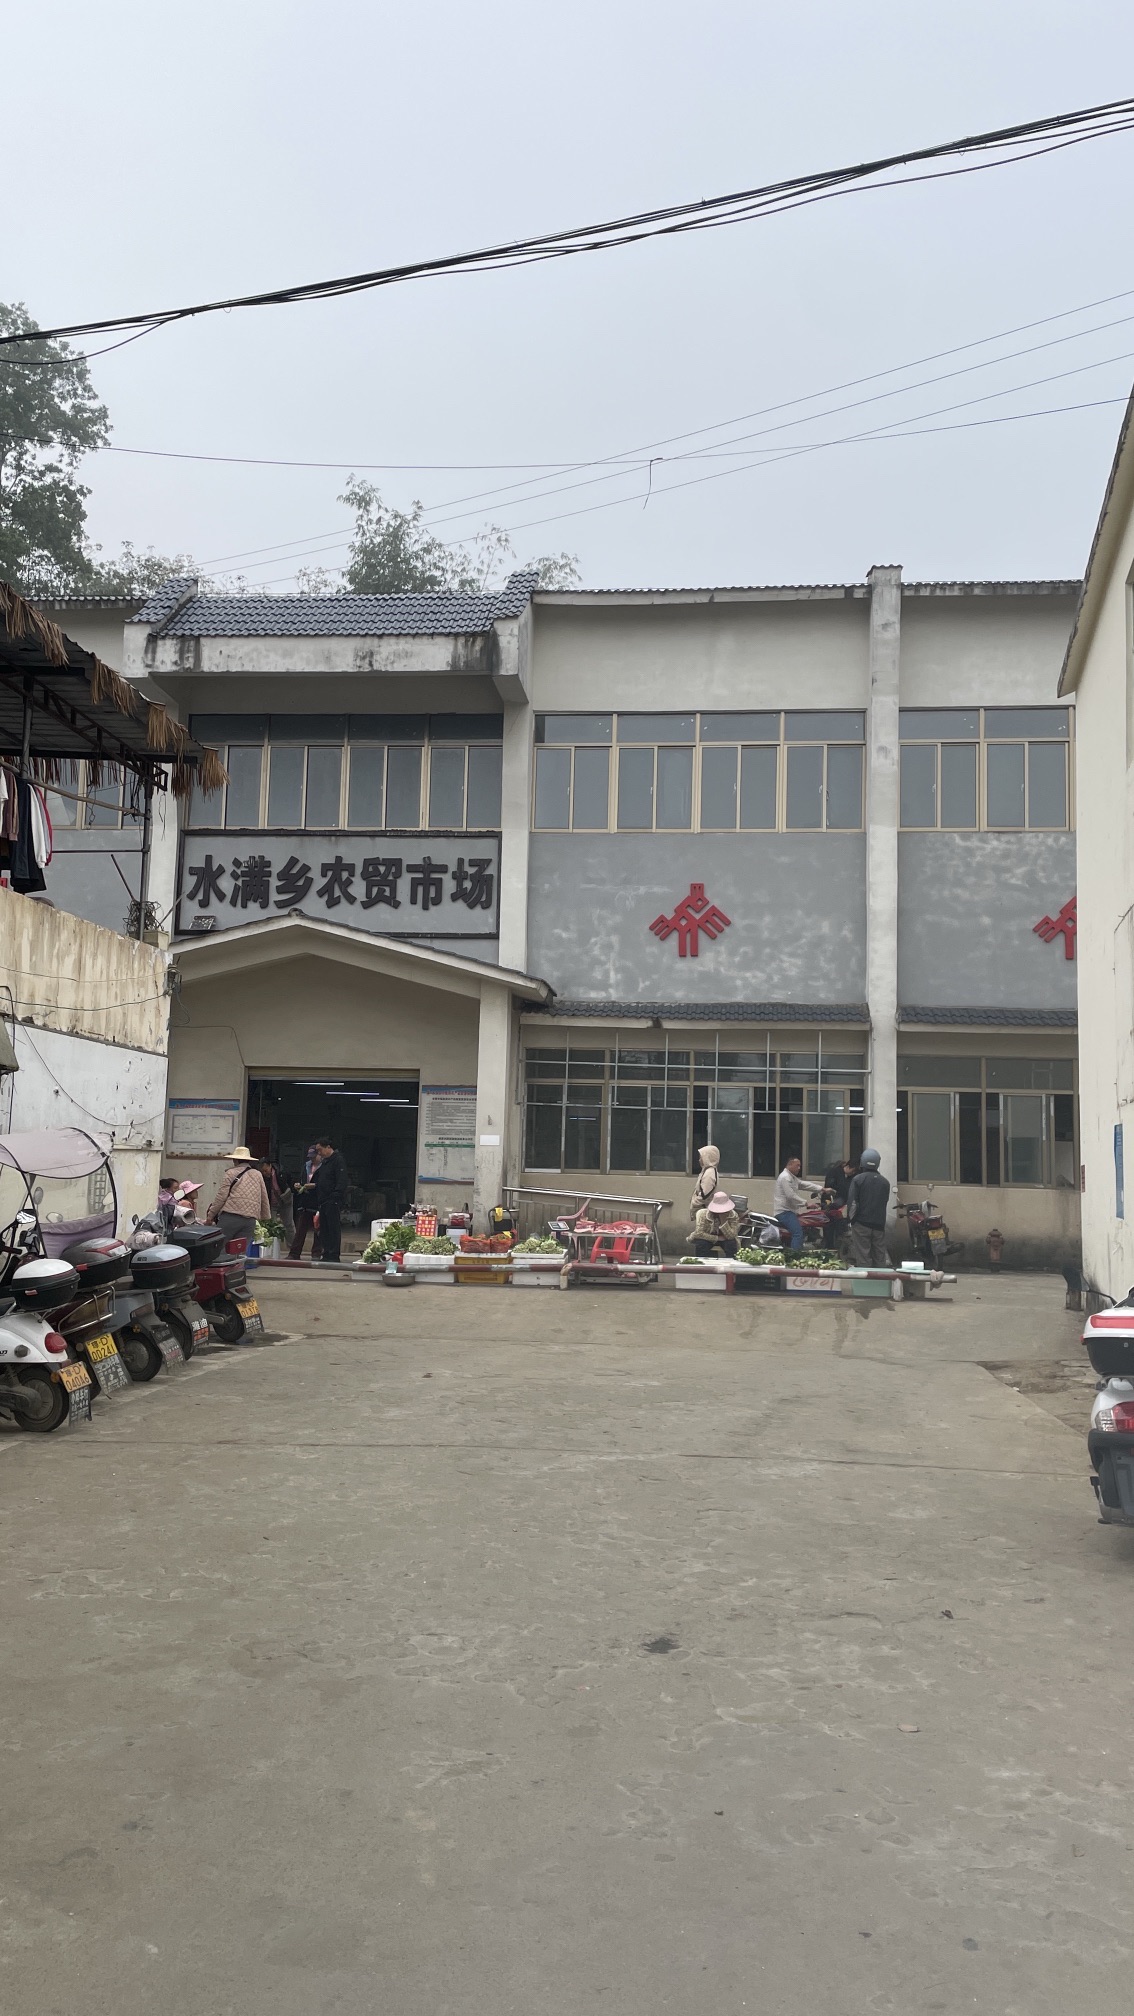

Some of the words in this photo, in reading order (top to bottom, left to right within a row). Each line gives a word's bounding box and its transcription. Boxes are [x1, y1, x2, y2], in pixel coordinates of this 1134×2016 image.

[186, 855, 494, 910] 水满乡农贸市场
